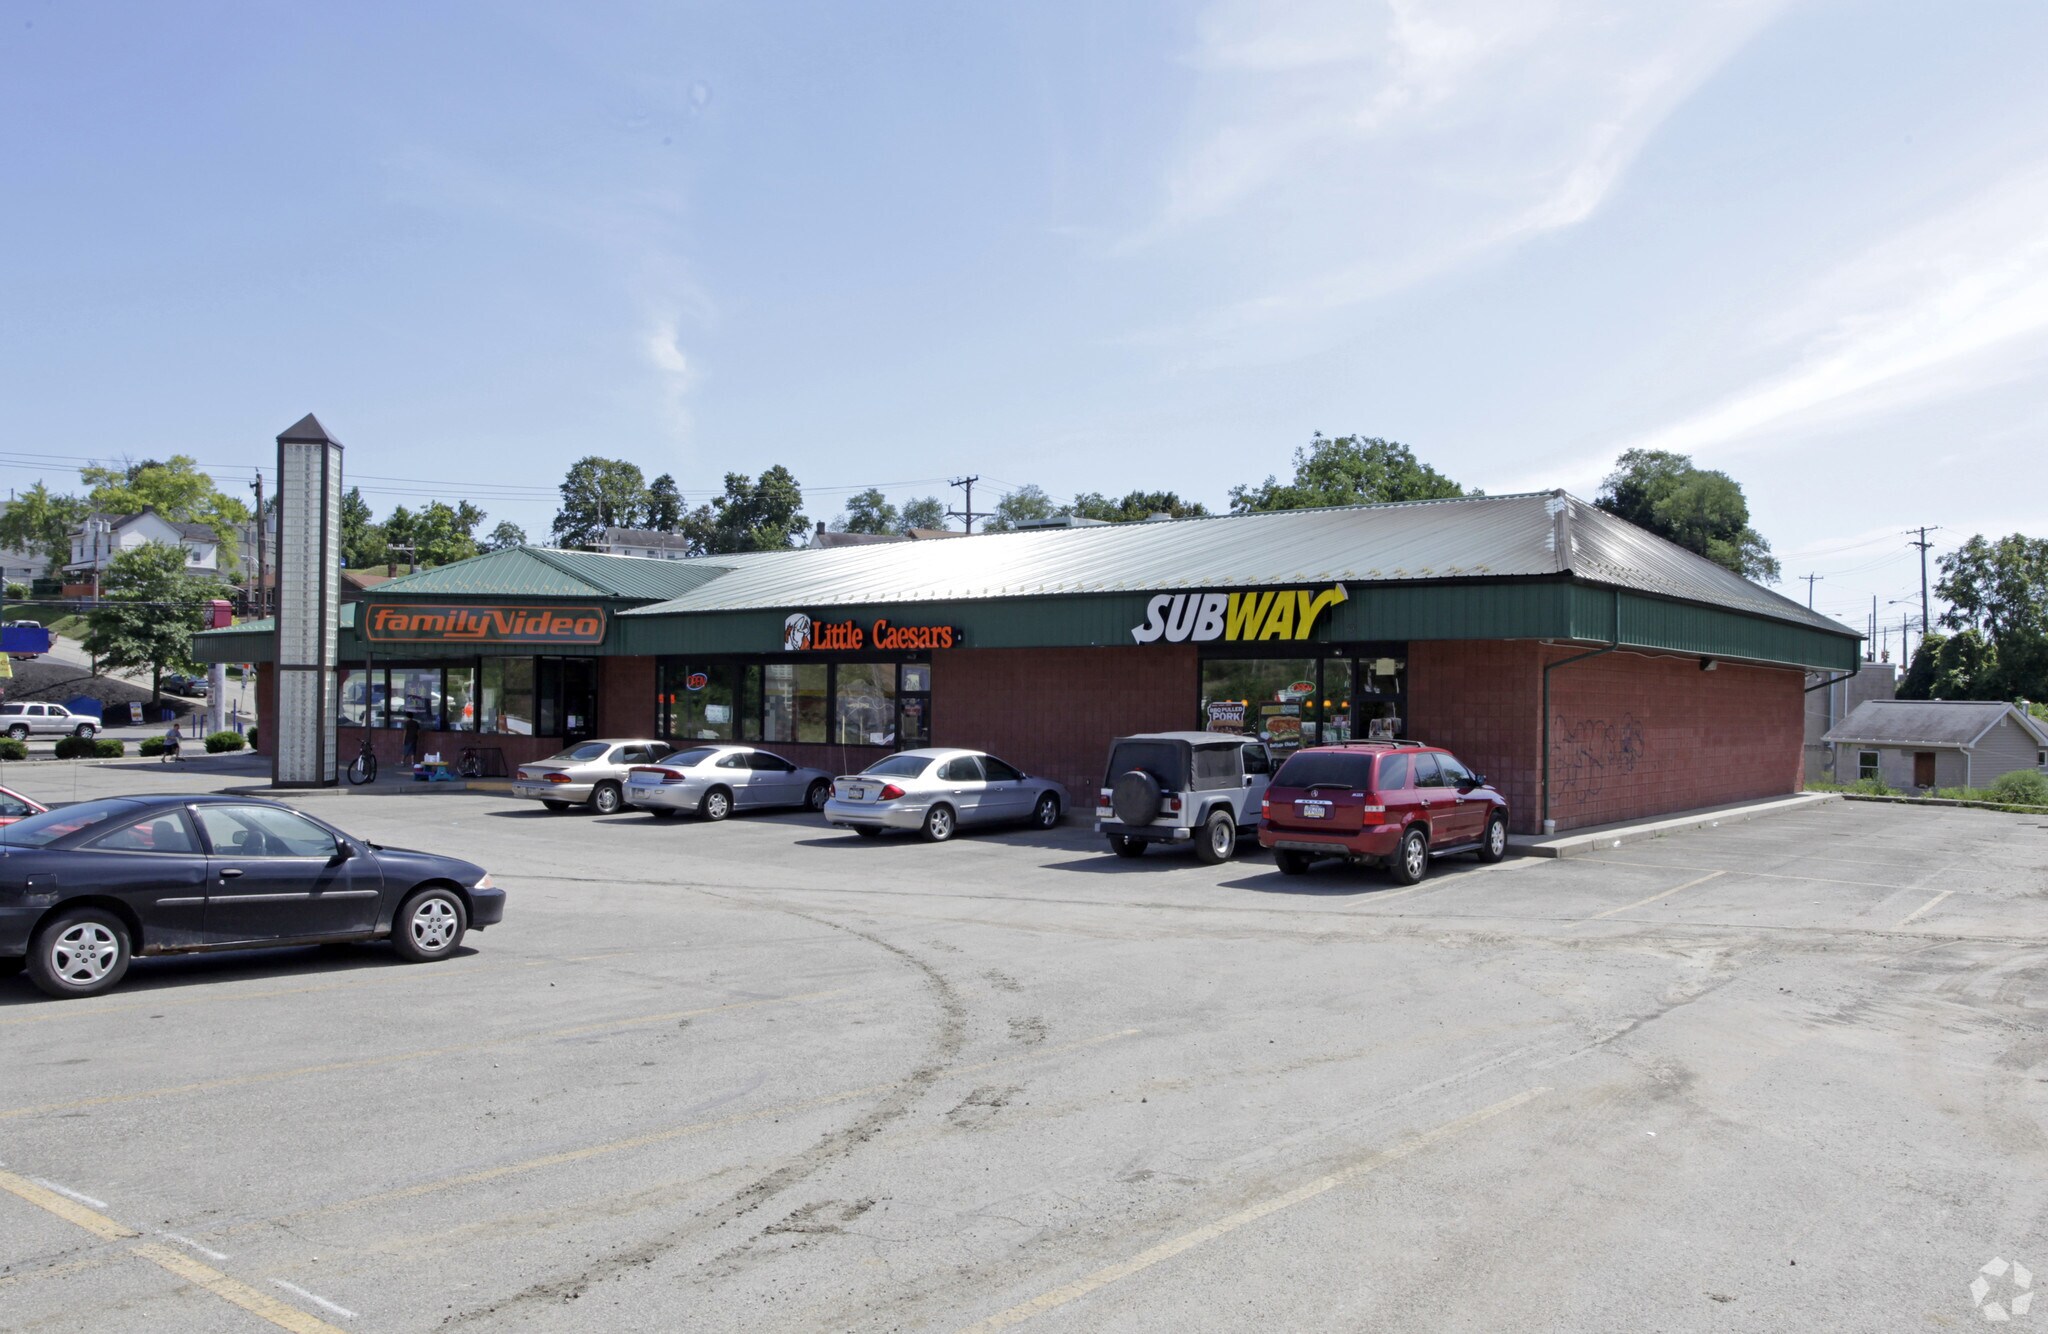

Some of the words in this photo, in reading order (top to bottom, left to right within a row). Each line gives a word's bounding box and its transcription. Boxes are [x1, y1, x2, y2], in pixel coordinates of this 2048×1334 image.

[1131, 583, 1349, 645] SUBWAY
[812, 620, 863, 650] Little
[873, 619, 953, 649] Caesars
[687, 675, 706, 687] OPEN
[1212, 712, 1241, 721] PORK
